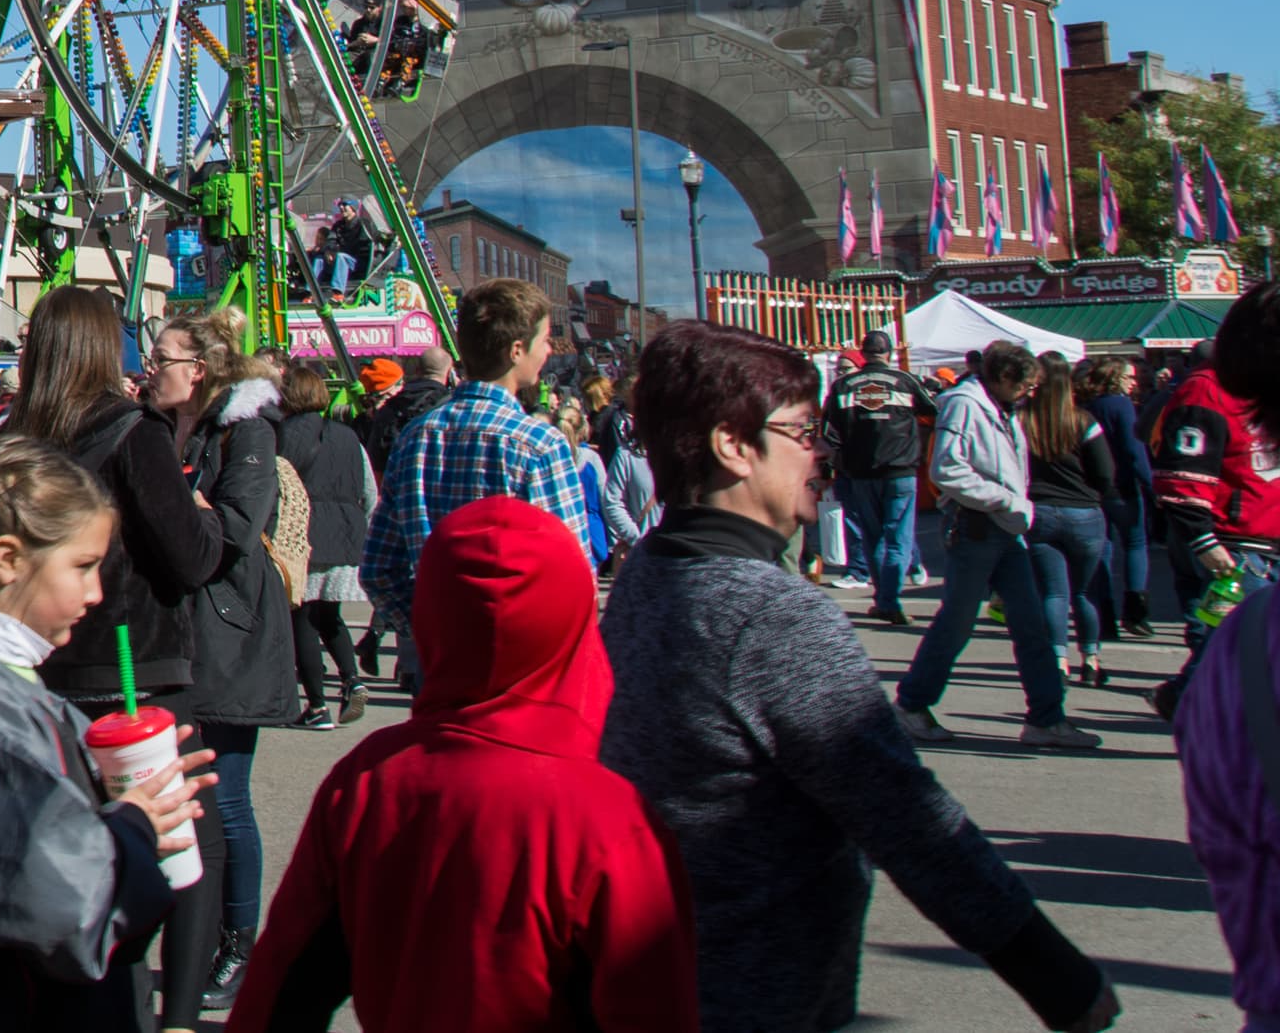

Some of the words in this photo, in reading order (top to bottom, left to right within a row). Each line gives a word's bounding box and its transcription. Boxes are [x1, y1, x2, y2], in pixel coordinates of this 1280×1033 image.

[933, 274, 1046, 297] Candy
[1071, 274, 1158, 294] Fudge
[340, 327, 391, 346] CANDY
